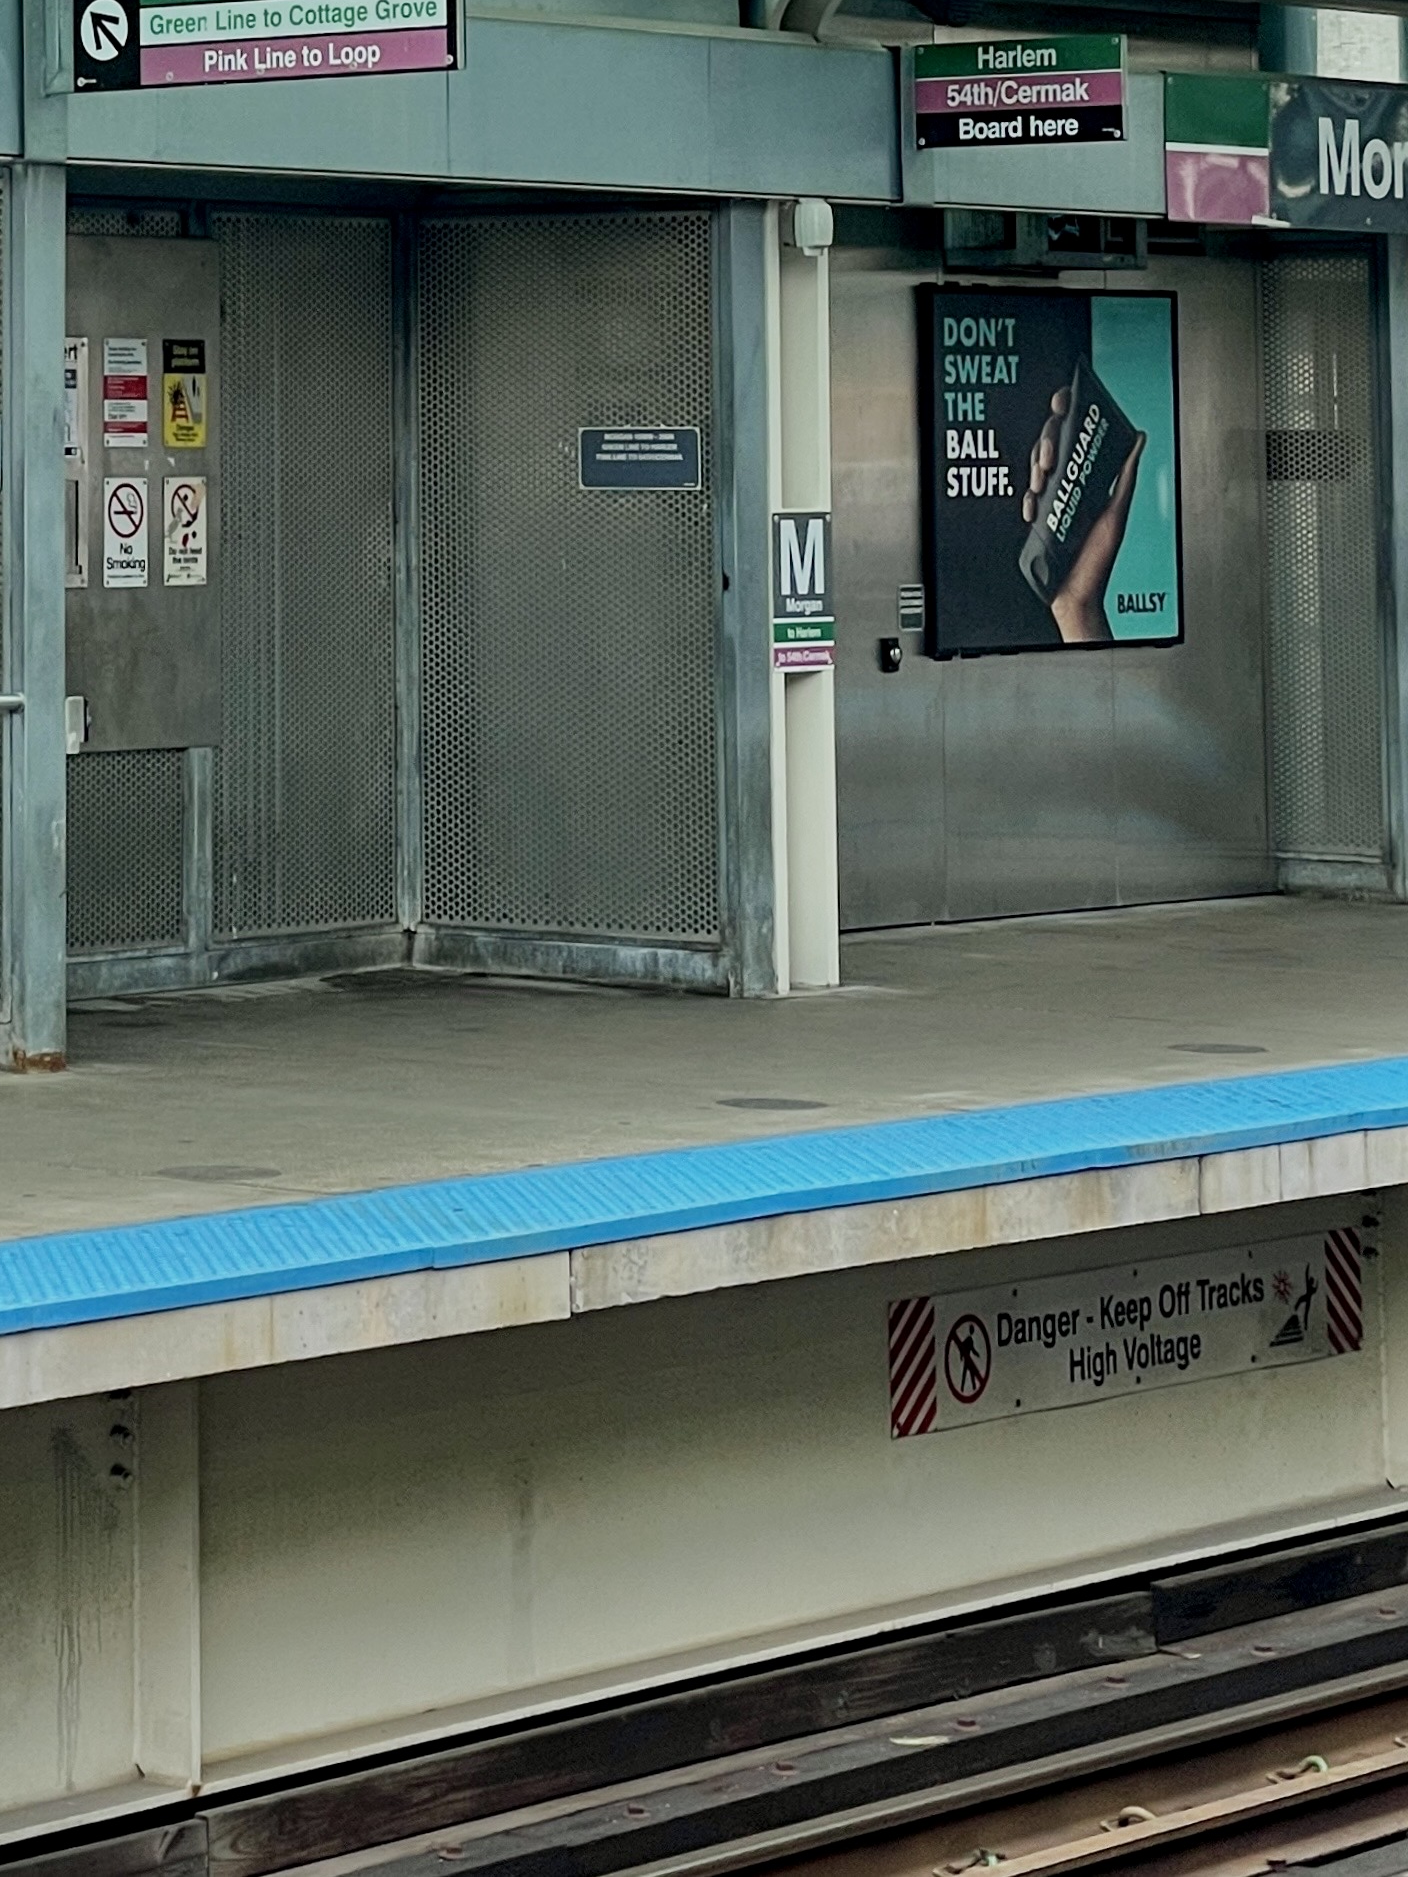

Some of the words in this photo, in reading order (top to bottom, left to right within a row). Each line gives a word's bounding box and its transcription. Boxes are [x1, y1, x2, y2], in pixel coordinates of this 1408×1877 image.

[149, 10, 208, 36] Green
[215, 5, 256, 32] Line
[262, 6, 283, 29] to
[289, 0, 368, 29] Cottage
[204, 46, 248, 73] Pink
[255, 43, 297, 71] Line
[301, 45, 322, 67] to
[328, 41, 381, 70] Loop
[977, 44, 1058, 71] Harlem
[946, 76, 1090, 108] 54th/Cermak
[958, 114, 1023, 141] Board
[1029, 112, 1080, 138] here
[943, 317, 1016, 348] DON'T
[944, 355, 1020, 386] SWEAT
[944, 392, 986, 422] THE
[946, 429, 1000, 460] BALL
[947, 466, 1015, 499] STUFF.
[1046, 403, 1102, 533] BALLGUARD
[1055, 487, 1083, 544] LIQUID
[1078, 417, 1111, 486] POWDER
[106, 556, 146, 572] Smoking
[119, 542, 133, 555] No
[780, 518, 825, 596] M
[785, 598, 824, 616] Morgan
[1117, 592, 1167, 615] BALLSY
[996, 1306, 1081, 1349] Danger
[1099, 1293, 1153, 1330] Keep
[1158, 1280, 1191, 1319] Off
[1196, 1272, 1266, 1311] Tracks
[1068, 1338, 1118, 1388] High
[1123, 1329, 1203, 1371] Voltage
